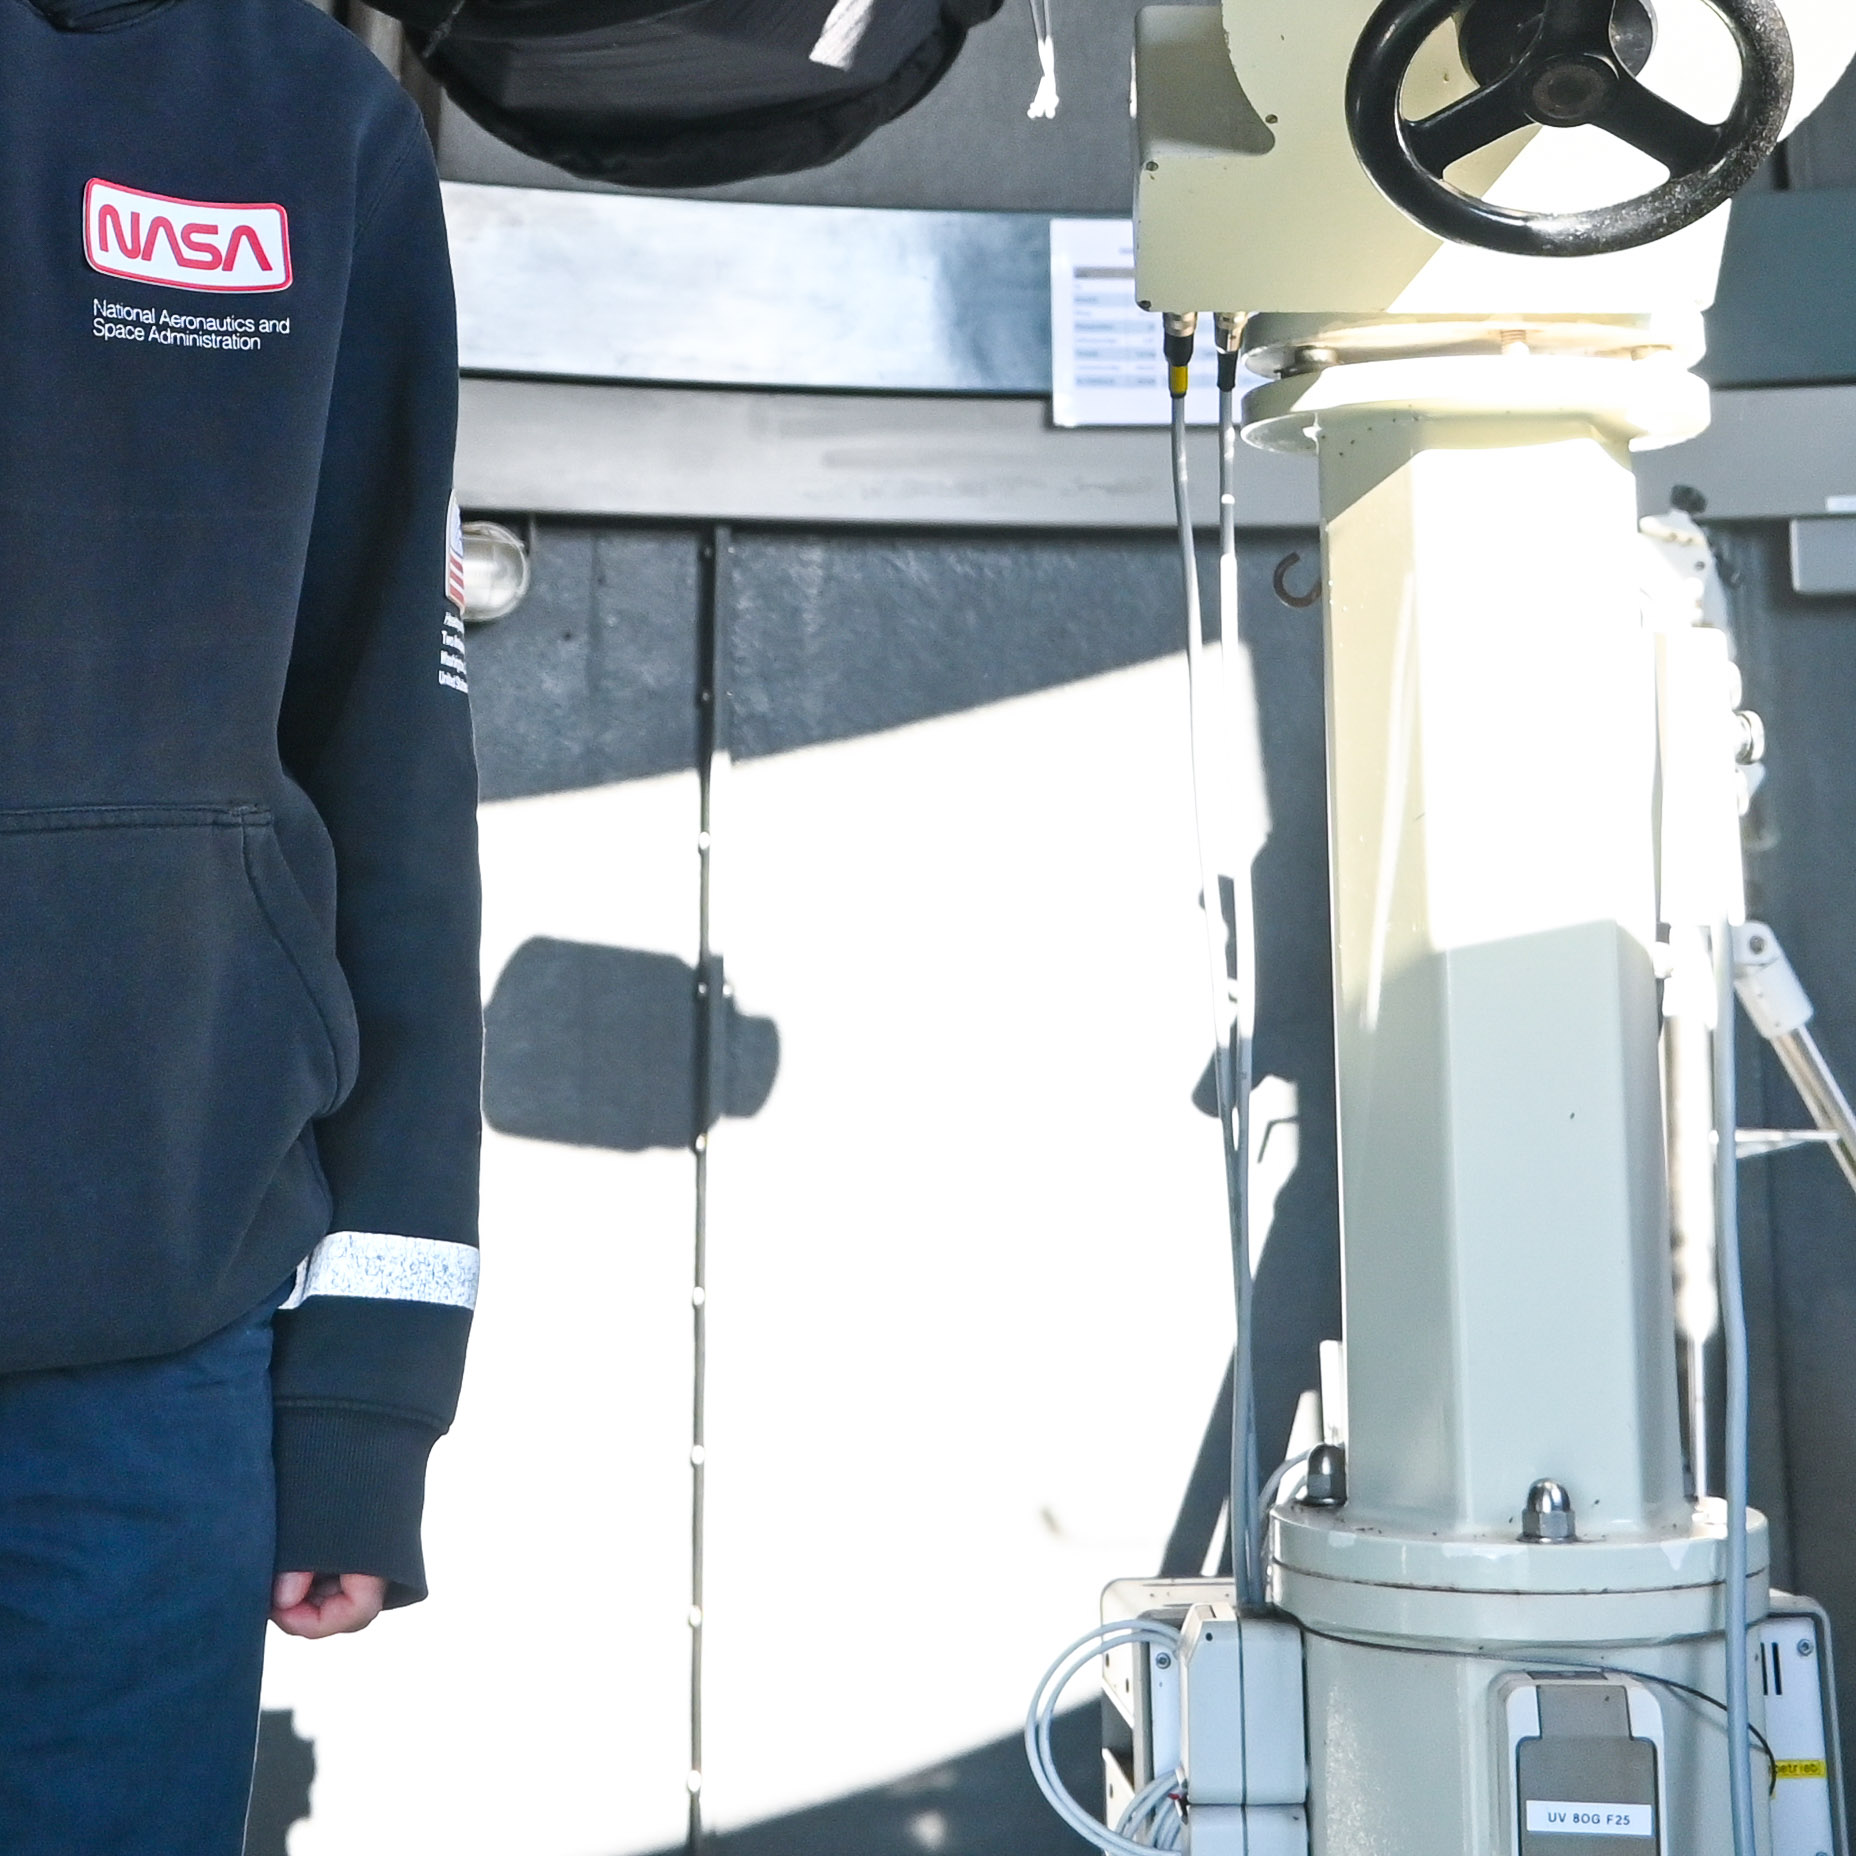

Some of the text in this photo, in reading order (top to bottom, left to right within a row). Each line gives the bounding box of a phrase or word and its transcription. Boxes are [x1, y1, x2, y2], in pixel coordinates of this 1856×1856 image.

[99, 204, 273, 272] NASA
[93, 298, 290, 335] National Aeronautics and
[93, 318, 261, 350] Space Administration
[1547, 1811, 1567, 1824] UV
[1606, 1814, 1632, 1827] F25
